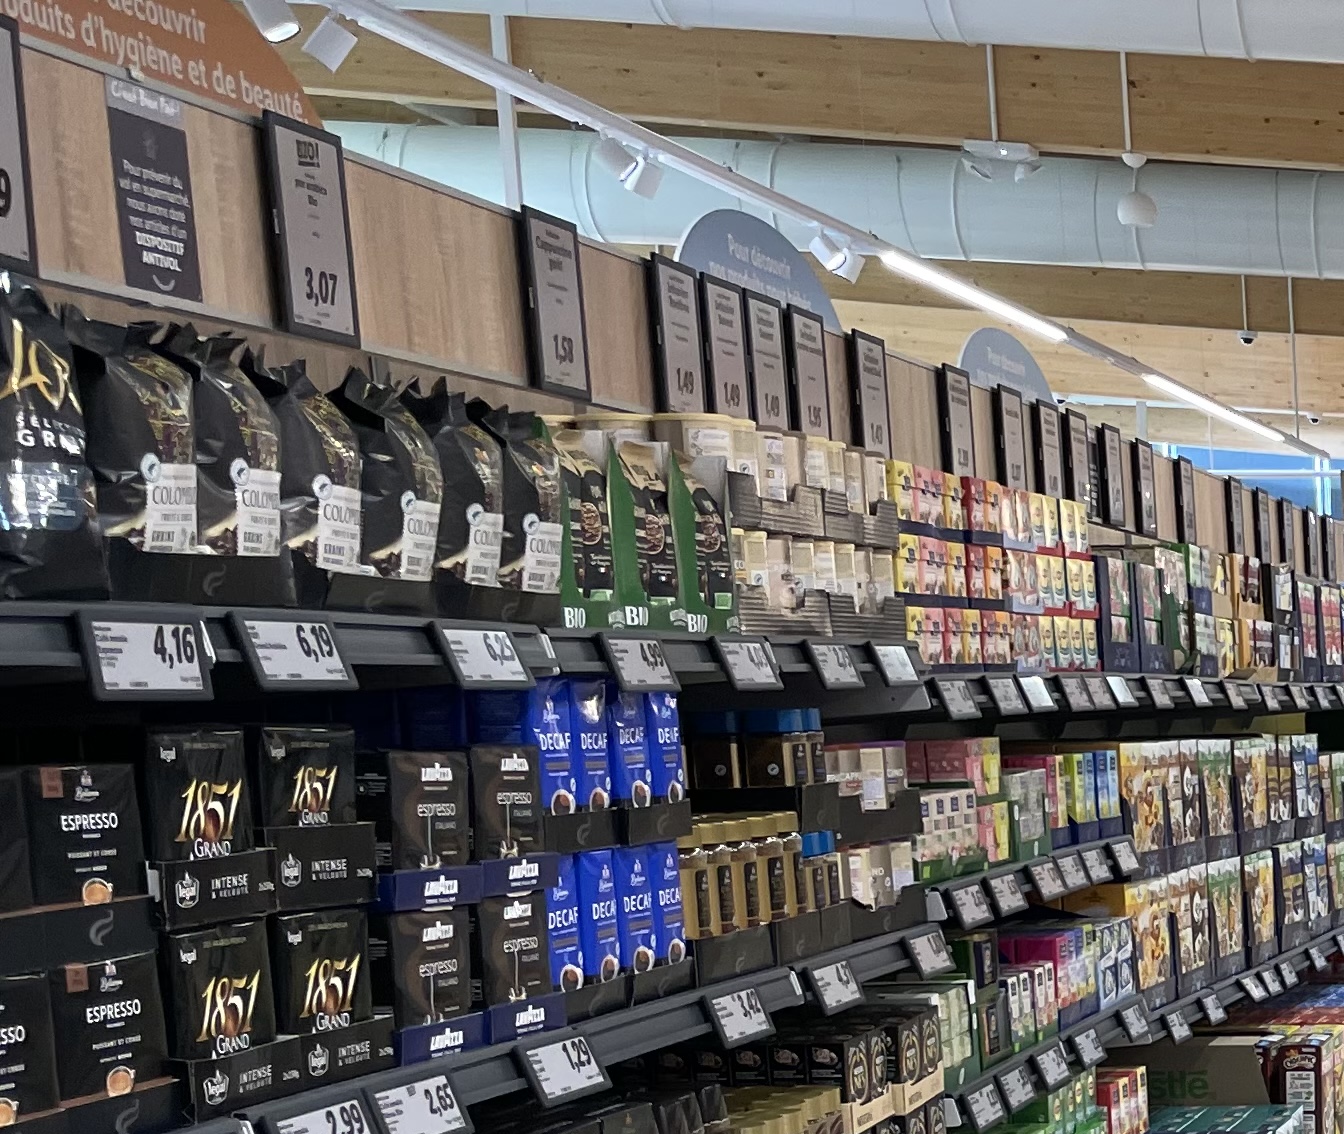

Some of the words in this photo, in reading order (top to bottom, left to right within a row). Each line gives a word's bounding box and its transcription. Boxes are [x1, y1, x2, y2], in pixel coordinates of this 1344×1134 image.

[80, 12, 184, 80] d'hygiène
[187, 60, 208, 89] et
[212, 62, 237, 98] de
[305, 266, 338, 307] 3,07
[564, 606, 586, 629] BIO
[153, 625, 195, 669] 4,16
[296, 624, 334, 663] 6,19
[60, 812, 118, 832] ESPRESSO
[174, 777, 243, 842] 1851
[417, 803, 456, 817] espresso
[193, 837, 232, 858] GRAND
[211, 872, 249, 889] INTENSE
[548, 905, 579, 930] DECAF
[300, 953, 361, 1018] 1851
[562, 1041, 592, 1073] 1,29
[423, 1081, 456, 1118] 2,65
